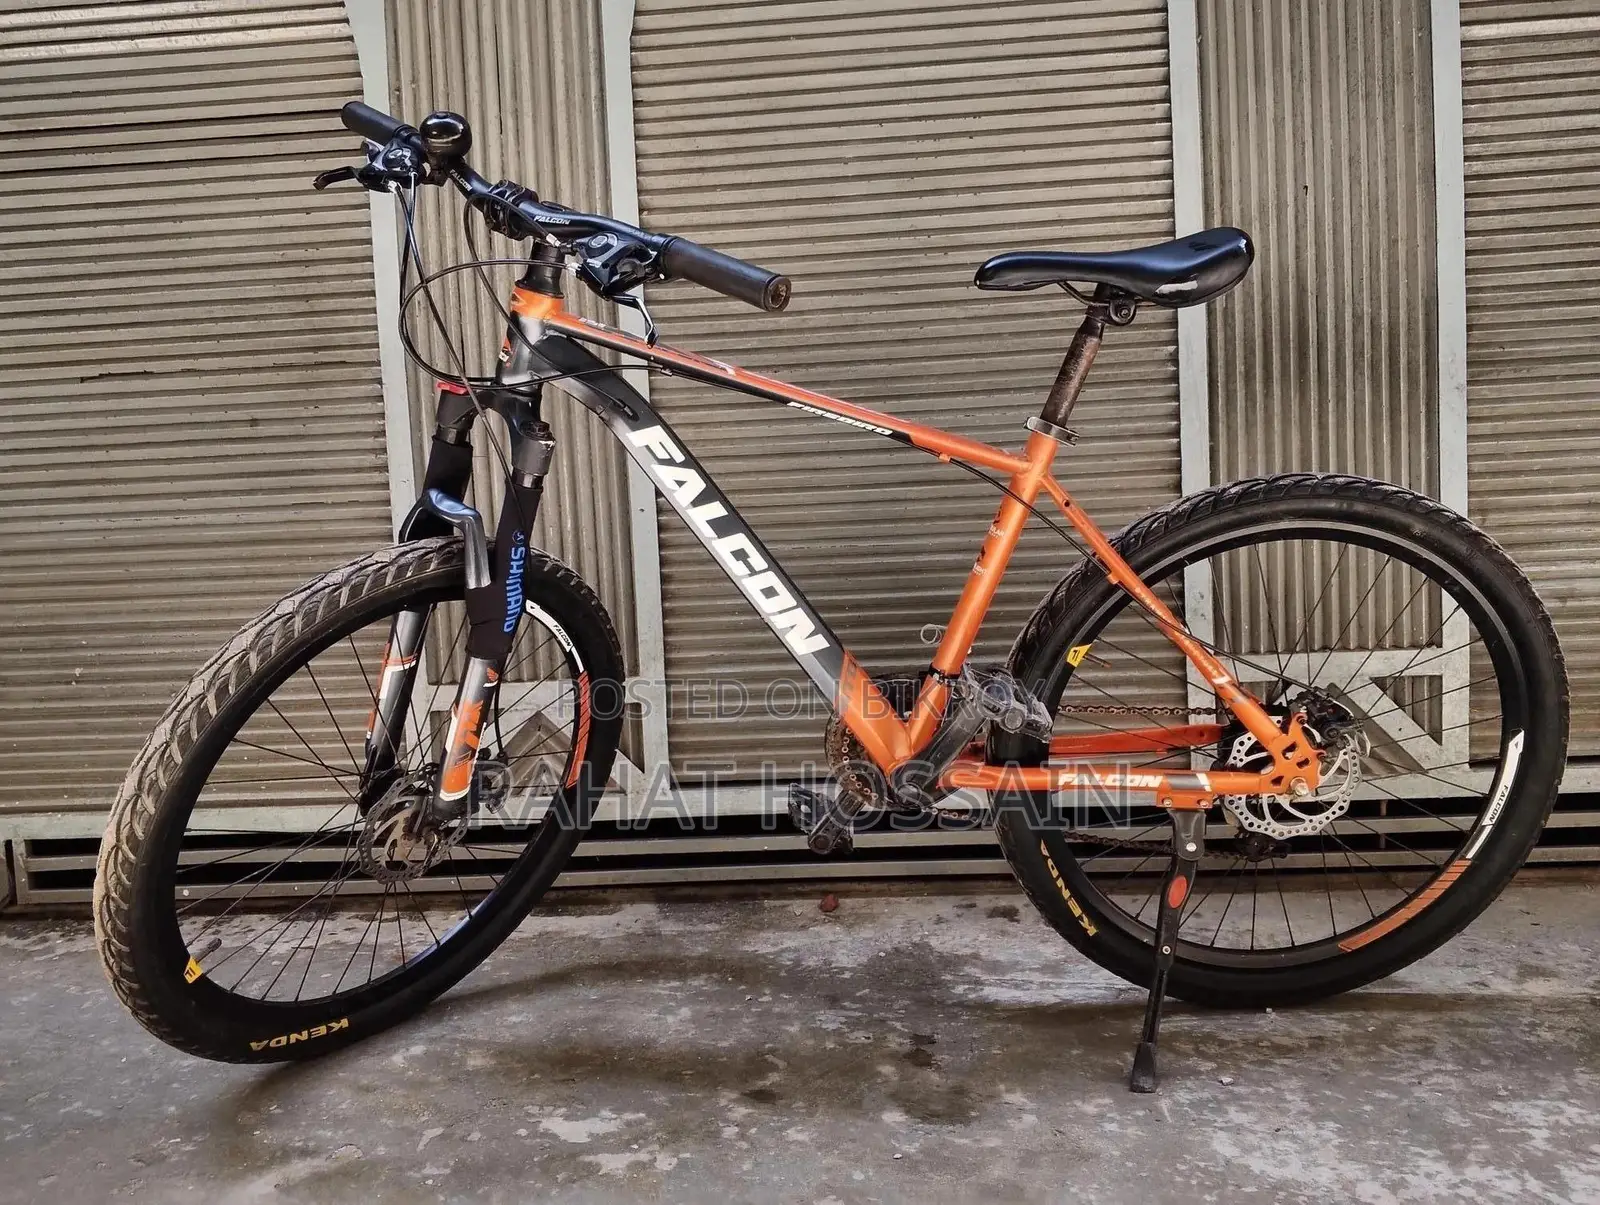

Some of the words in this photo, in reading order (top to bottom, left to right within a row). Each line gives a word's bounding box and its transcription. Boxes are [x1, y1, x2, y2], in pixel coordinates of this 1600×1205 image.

[449, 168, 473, 192] FALCON
[533, 215, 571, 225] FALCON
[626, 425, 831, 656] FALCON
[503, 546, 526, 633] SHIMANO
[553, 624, 572, 647] FALCON
[1058, 773, 1164, 788] FALCON
[1489, 784, 1509, 823] FALCON
[1040, 838, 1098, 937] KENDA
[249, 1017, 350, 1052] KENDA
